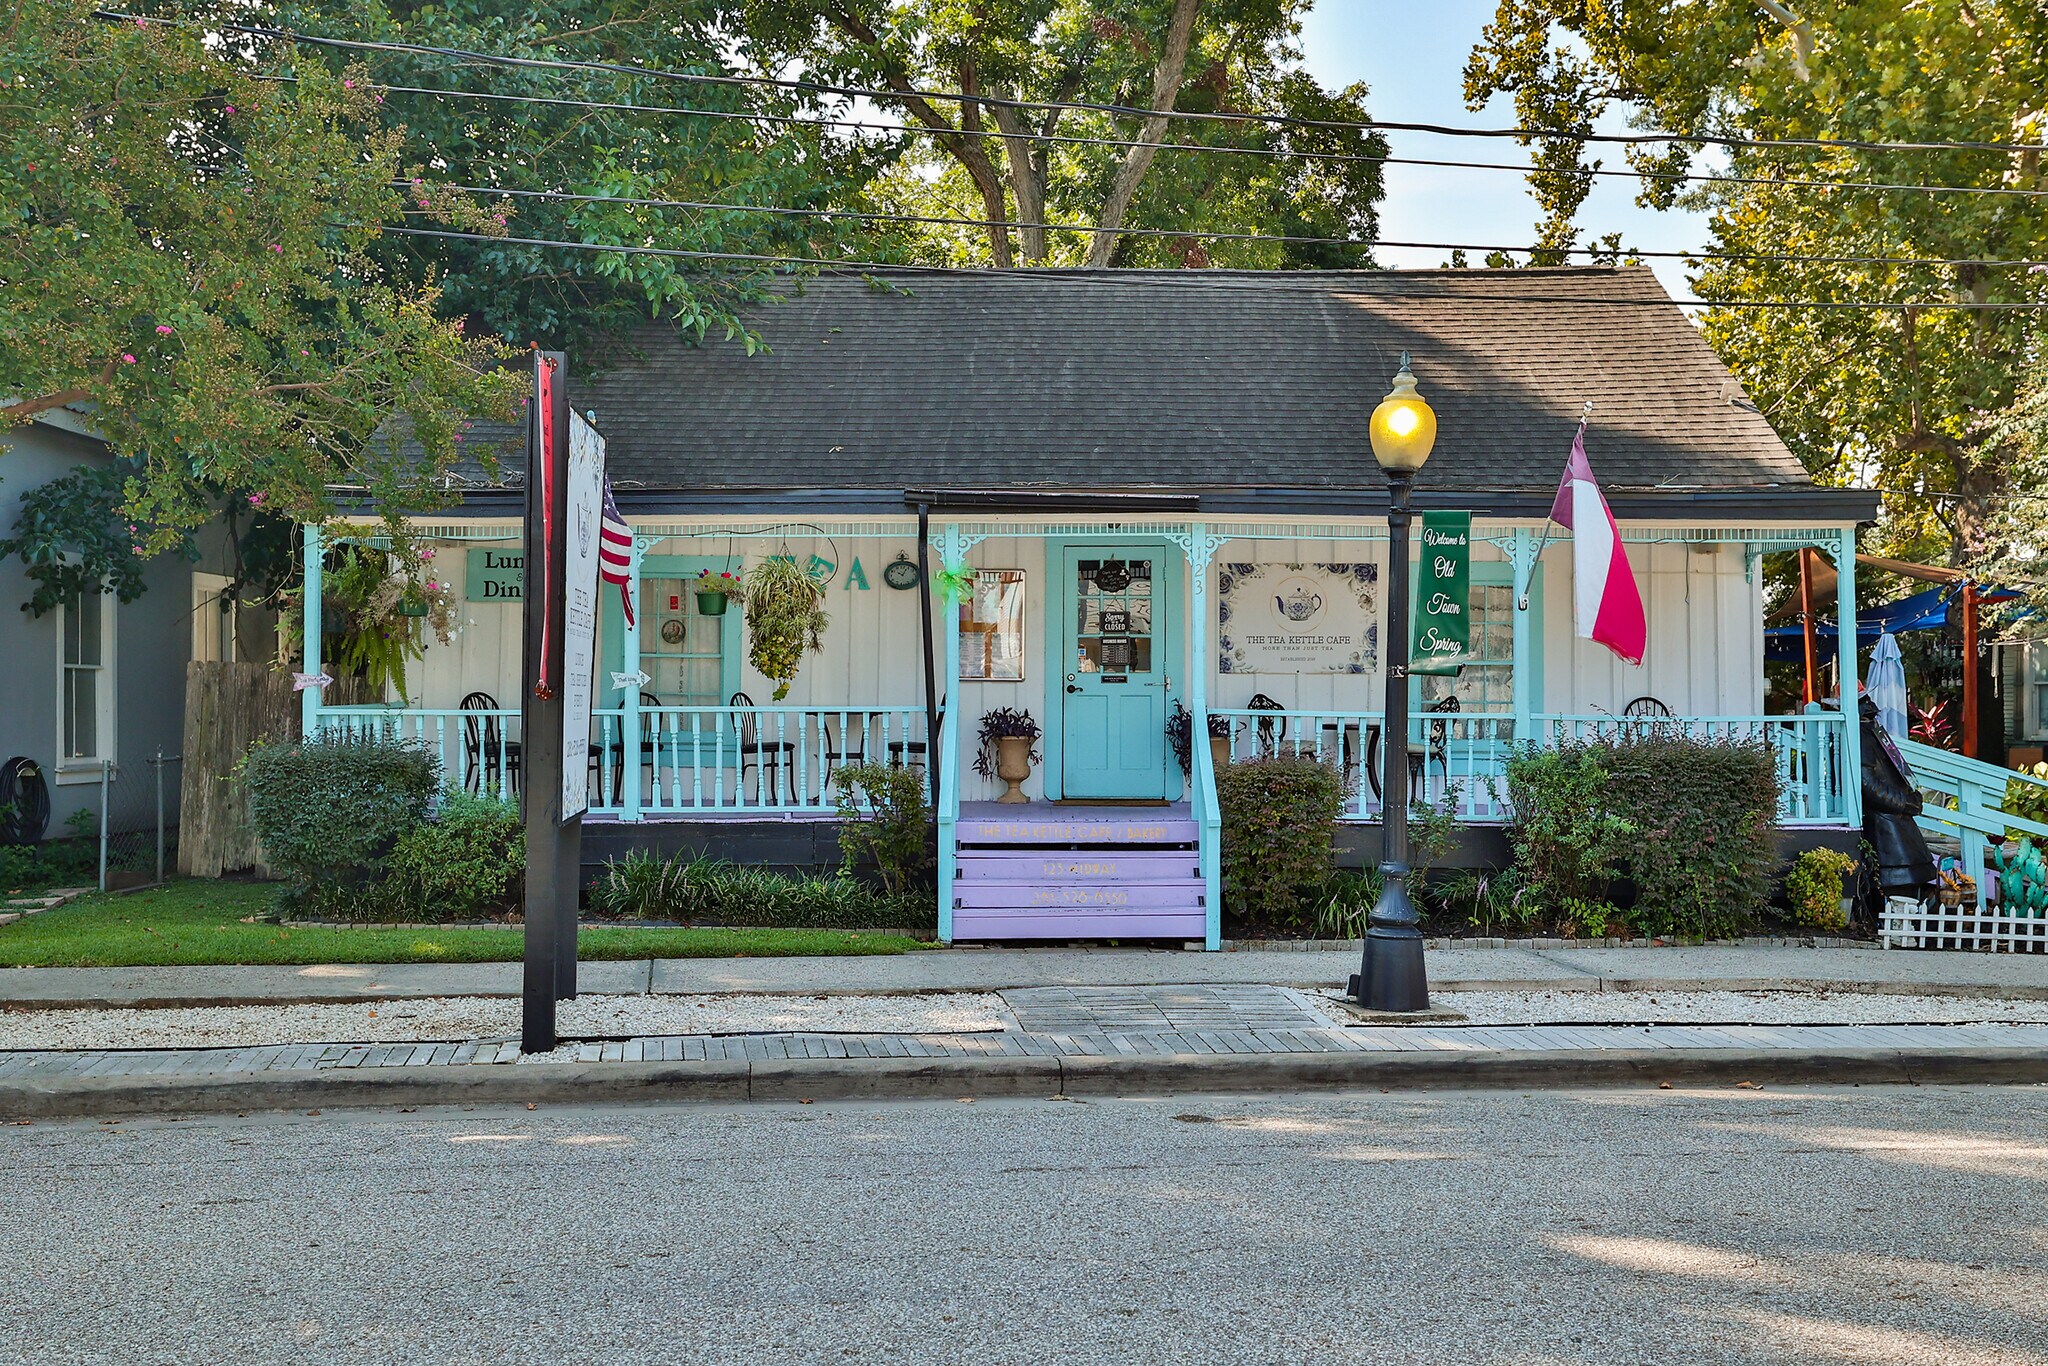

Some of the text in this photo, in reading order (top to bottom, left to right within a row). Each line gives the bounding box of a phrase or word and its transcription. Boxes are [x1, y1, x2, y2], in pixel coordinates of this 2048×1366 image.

[1424, 528, 1466, 546] Welcome to
[485, 552, 524, 568] Lun
[1434, 556, 1456, 578] Old
[1195, 546, 1203, 595] 123
[483, 580, 524, 597] Din
[1426, 592, 1461, 615] Town
[1104, 612, 1125, 622] Sorry
[1246, 636, 1351, 644] THE TEA KETTLE CAFE
[1420, 628, 1462, 658] Spring
[978, 825, 1000, 837] THE
[1006, 825, 1029, 838] TEA
[1033, 826, 1071, 839] KETTLE
[1078, 826, 1112, 839] CAFE
[1127, 827, 1167, 839] BAKERY
